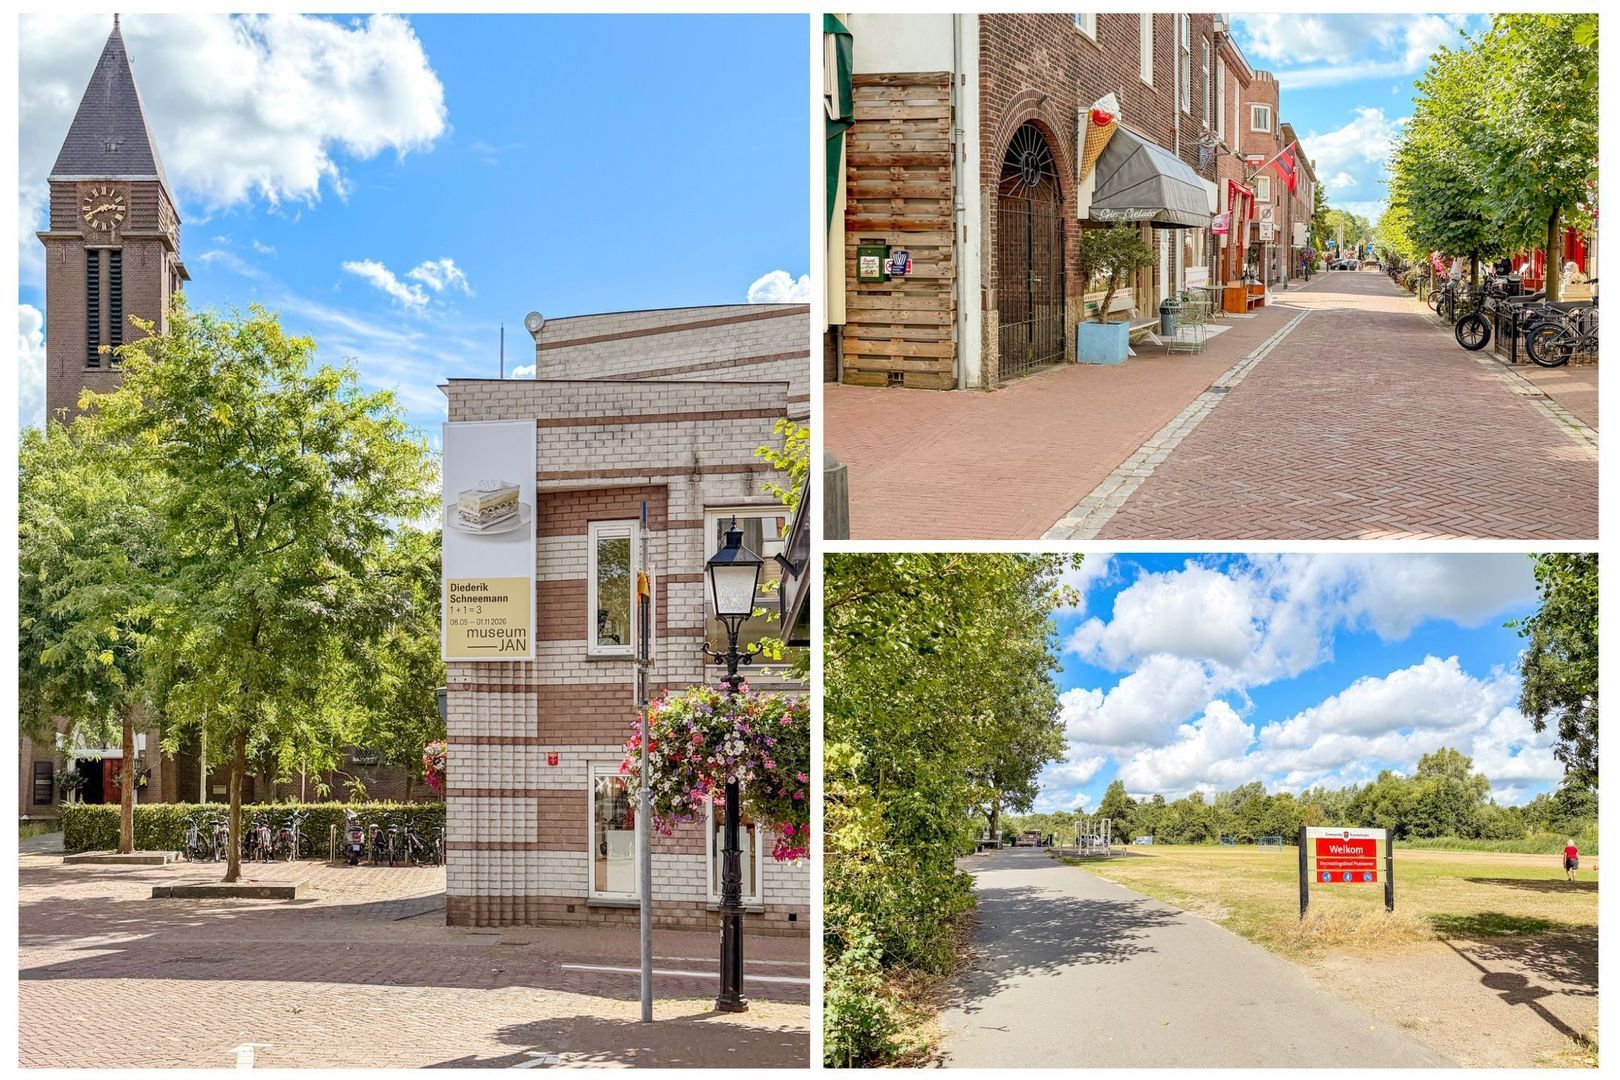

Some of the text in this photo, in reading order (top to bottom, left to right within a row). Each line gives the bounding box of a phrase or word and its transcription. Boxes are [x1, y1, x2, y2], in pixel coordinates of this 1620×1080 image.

[450, 582, 489, 592] Diederik
[450, 594, 509, 603] Schneemann
[450, 605, 454, 614] 1
[476, 605, 482, 614] 3
[466, 627, 527, 639] museum
[498, 639, 527, 652] JAN
[1328, 844, 1364, 854] Welkom
